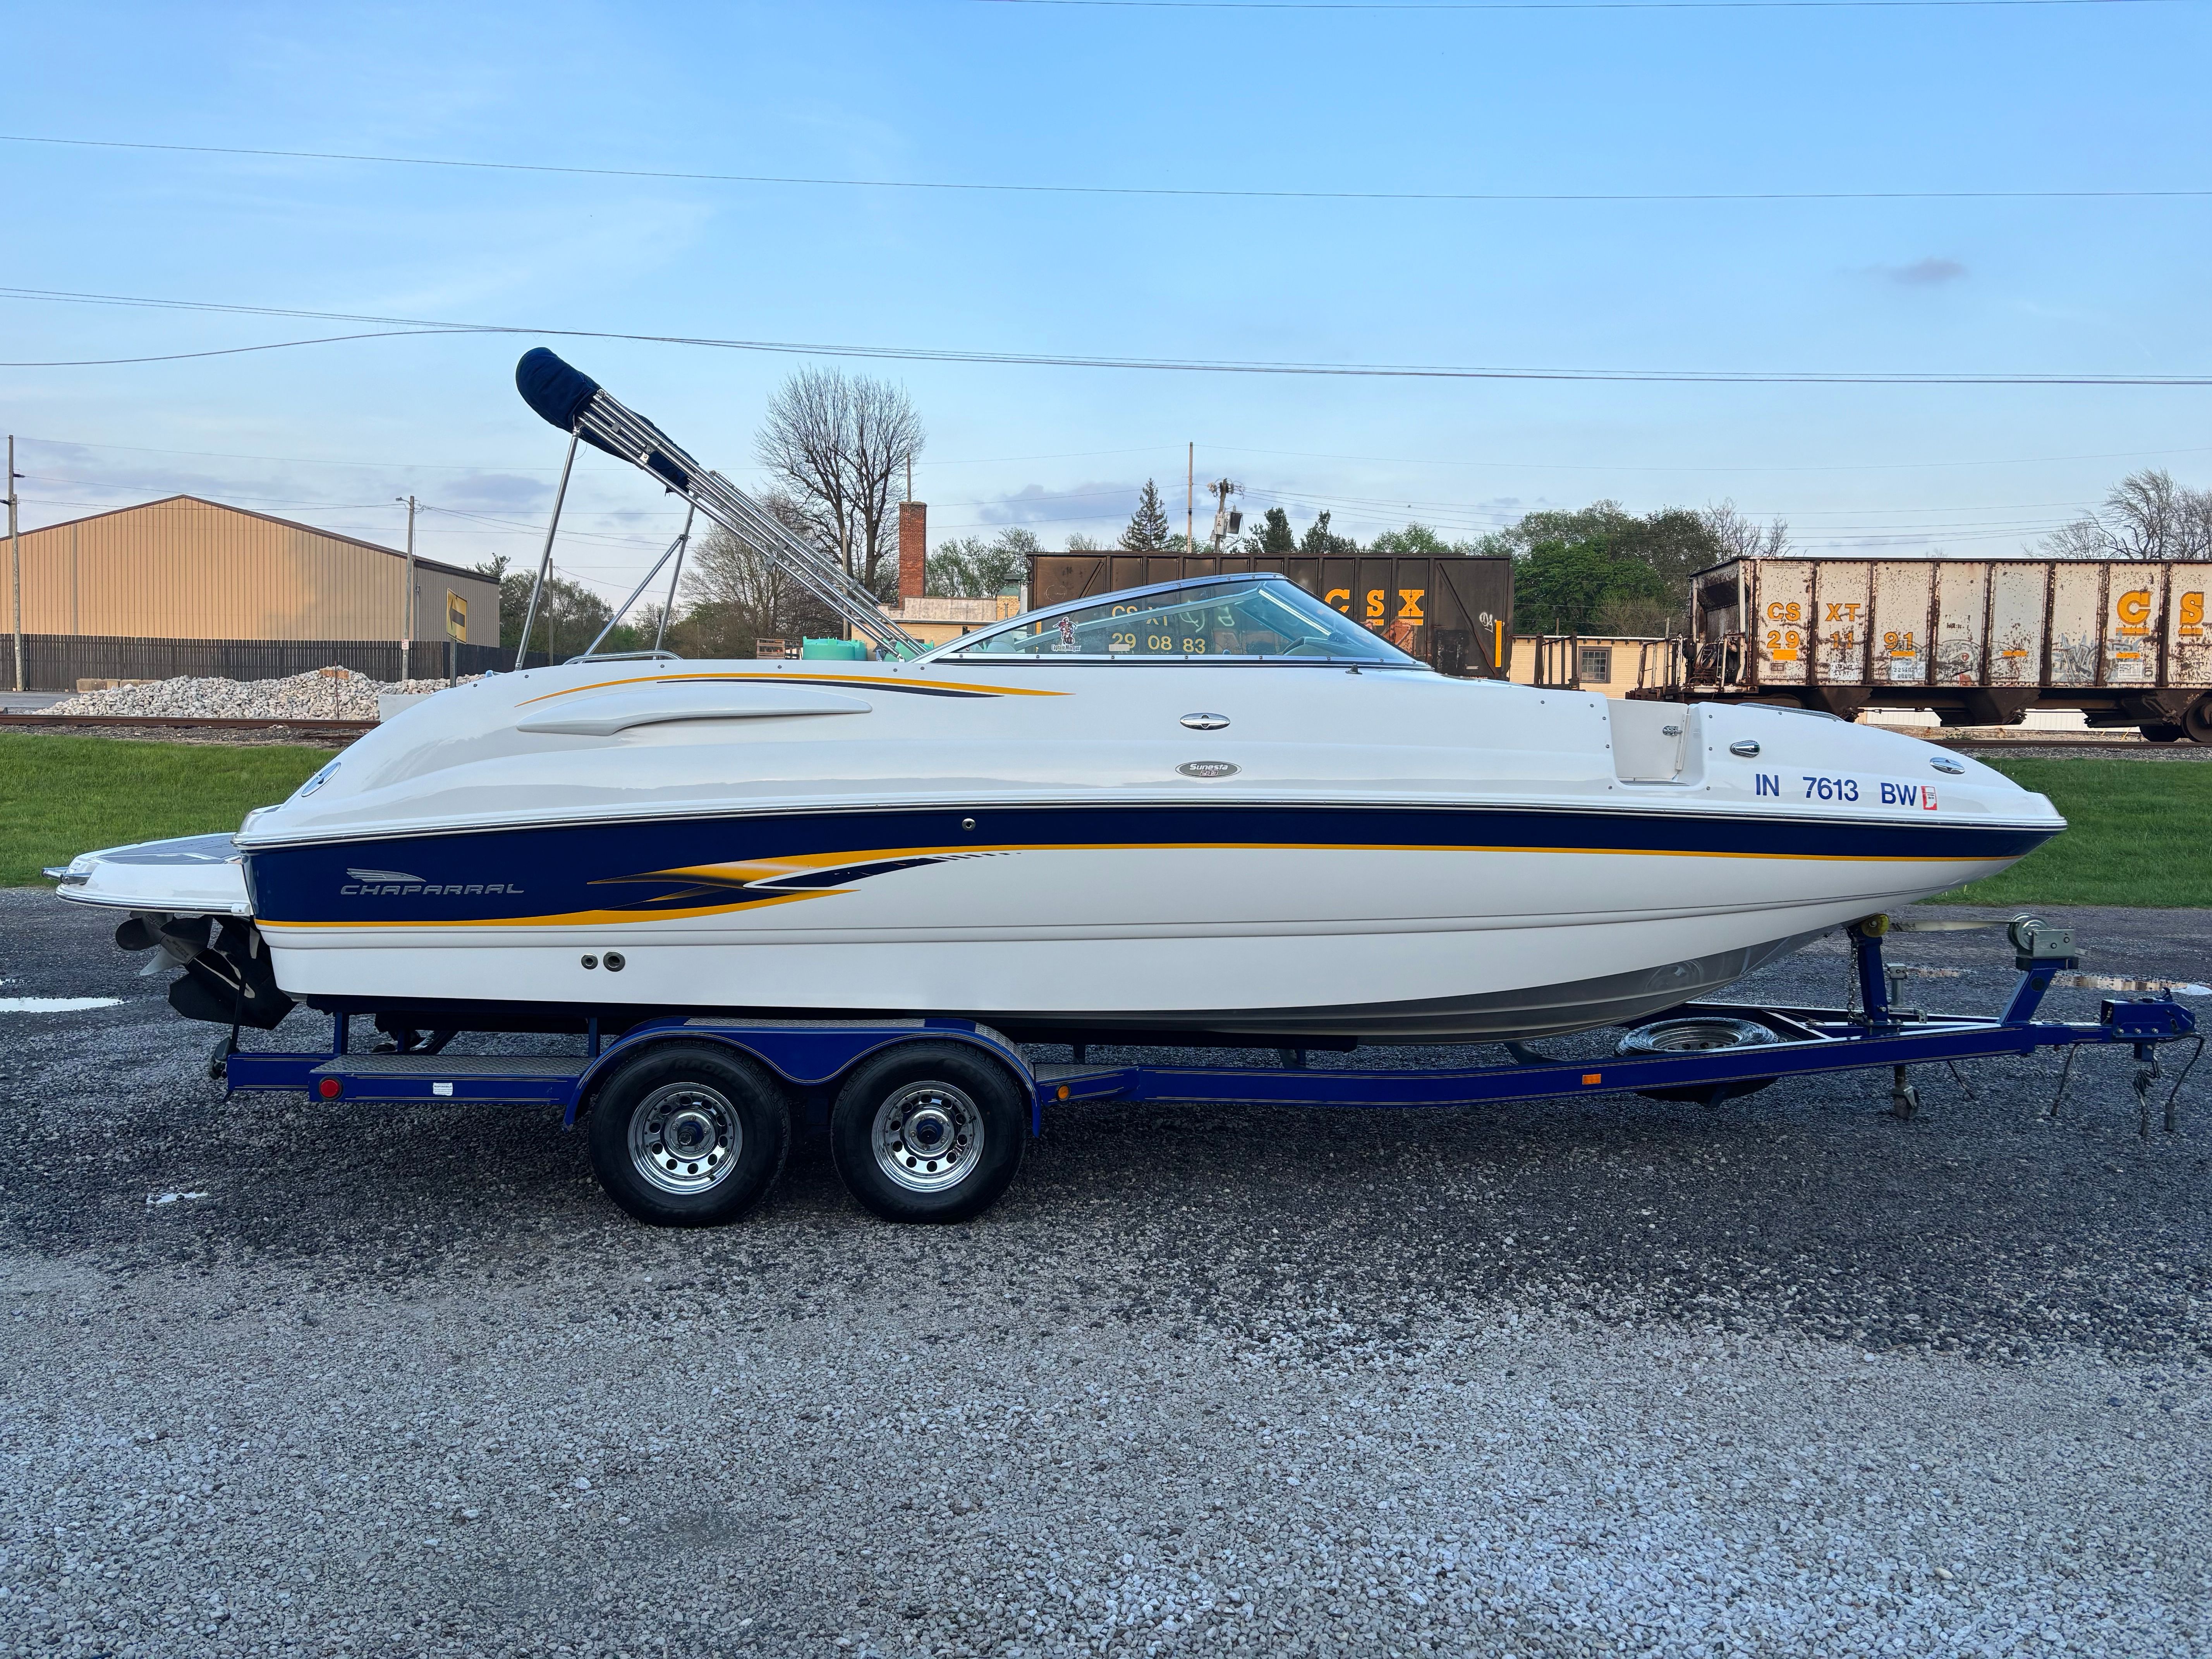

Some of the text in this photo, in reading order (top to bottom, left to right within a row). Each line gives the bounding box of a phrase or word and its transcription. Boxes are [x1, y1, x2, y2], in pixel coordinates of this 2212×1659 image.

[1324, 589, 1425, 617] CSX
[1767, 602, 1860, 622] CS XT
[1112, 633, 1205, 654] 29 08 83
[1767, 630, 1913, 649] 29 11 91
[1756, 774, 1917, 806] IN 7613 BW
[341, 884, 524, 895] CHAPARRAL
